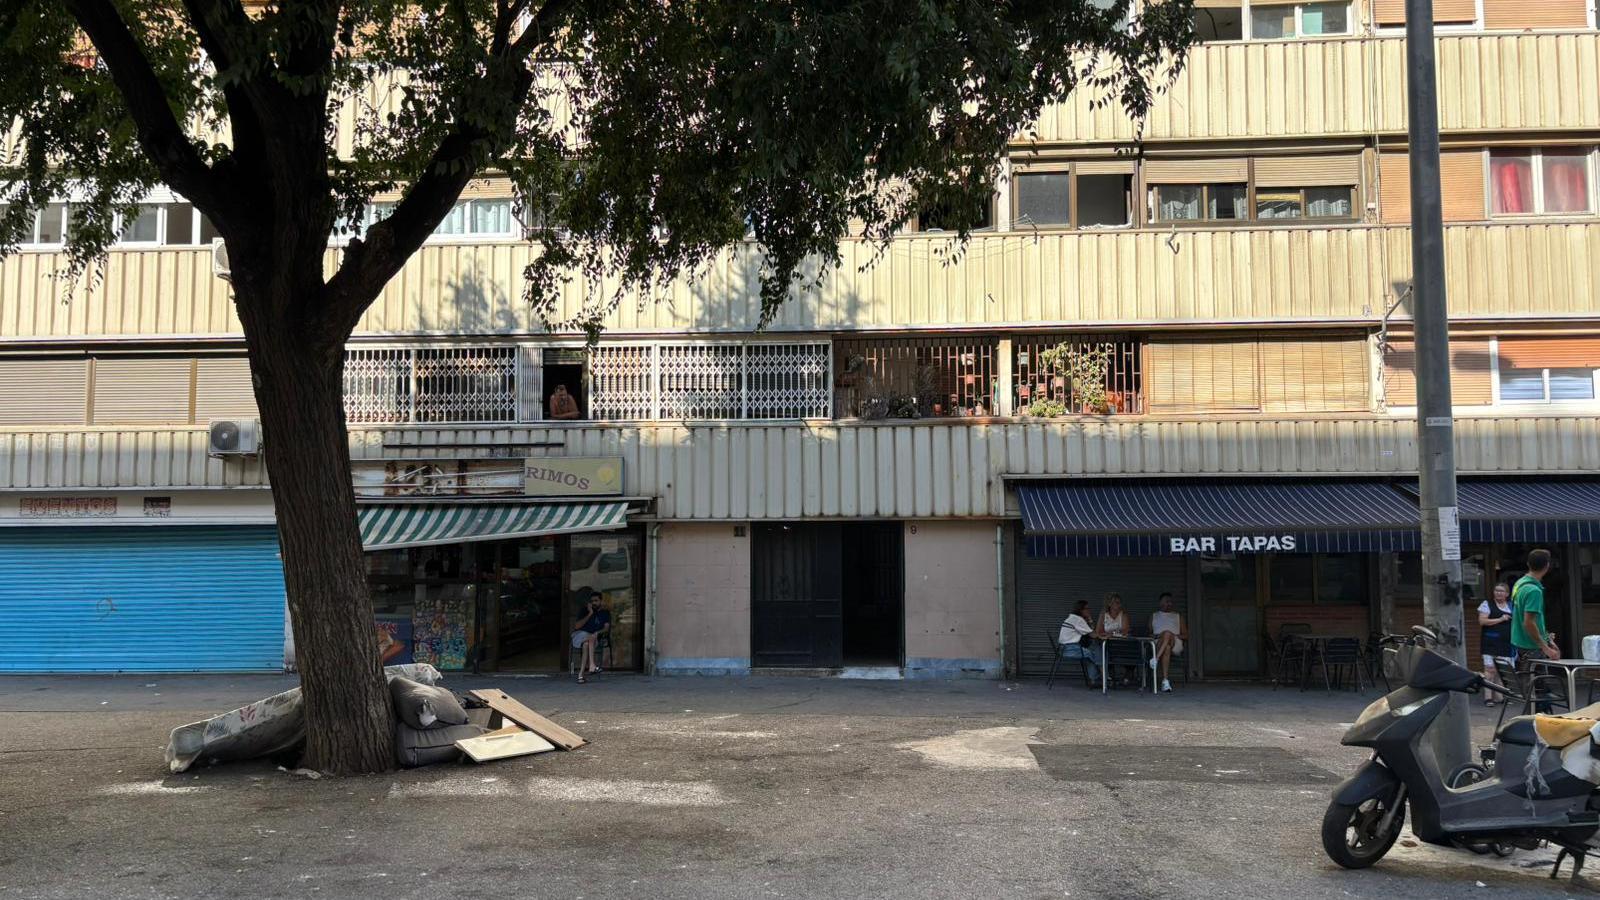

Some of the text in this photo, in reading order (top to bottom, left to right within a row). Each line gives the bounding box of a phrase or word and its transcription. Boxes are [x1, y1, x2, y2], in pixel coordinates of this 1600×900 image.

[527, 466, 591, 490] RIMOS
[1169, 535, 1296, 553] BAR TAPAS
